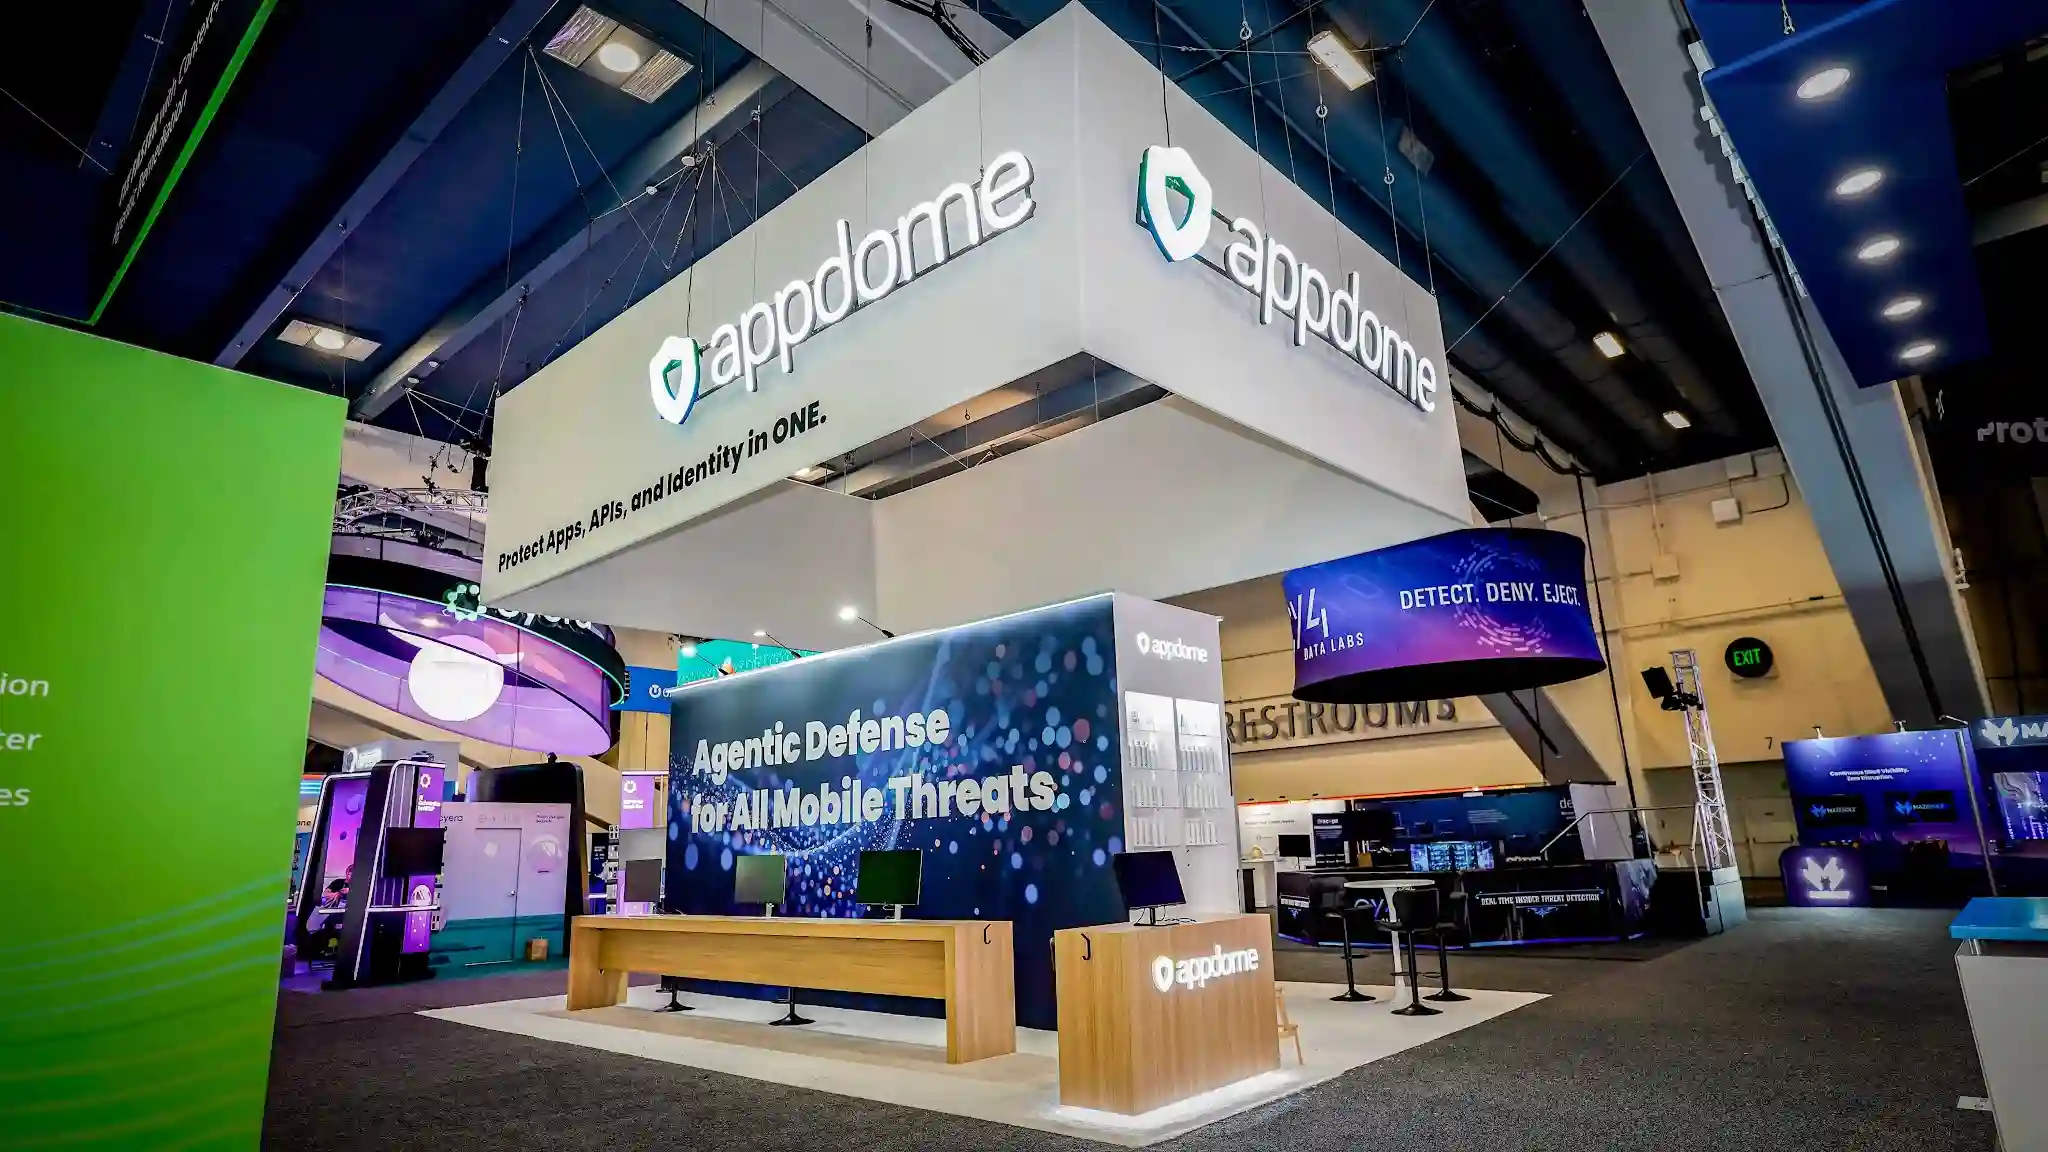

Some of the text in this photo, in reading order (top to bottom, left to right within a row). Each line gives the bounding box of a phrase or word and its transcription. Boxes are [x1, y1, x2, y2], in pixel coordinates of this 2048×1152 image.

[710, 150, 1037, 393] appdome
[1223, 217, 1437, 413] appdome
[498, 400, 827, 573] Protect Apps, APIs, and Identity in ONE.
[1399, 581, 1581, 611] DETECT. DENY. EJECT.
[1151, 637, 1209, 663] appdome
[1303, 631, 1364, 661] DATA LABS
[1733, 647, 1760, 667] EXIT
[692, 708, 951, 786] Agentic Defense
[1764, 736, 1773, 750] 7
[690, 793, 728, 834] for
[726, 789, 768, 832] All
[773, 776, 884, 829] Mobile
[1481, 897, 1498, 906] REAL
[1499, 896, 1514, 905] TIME
[1541, 894, 1565, 904] THREAT
[1566, 893, 1600, 902] DETECTION
[1174, 943, 1259, 990] appdome
